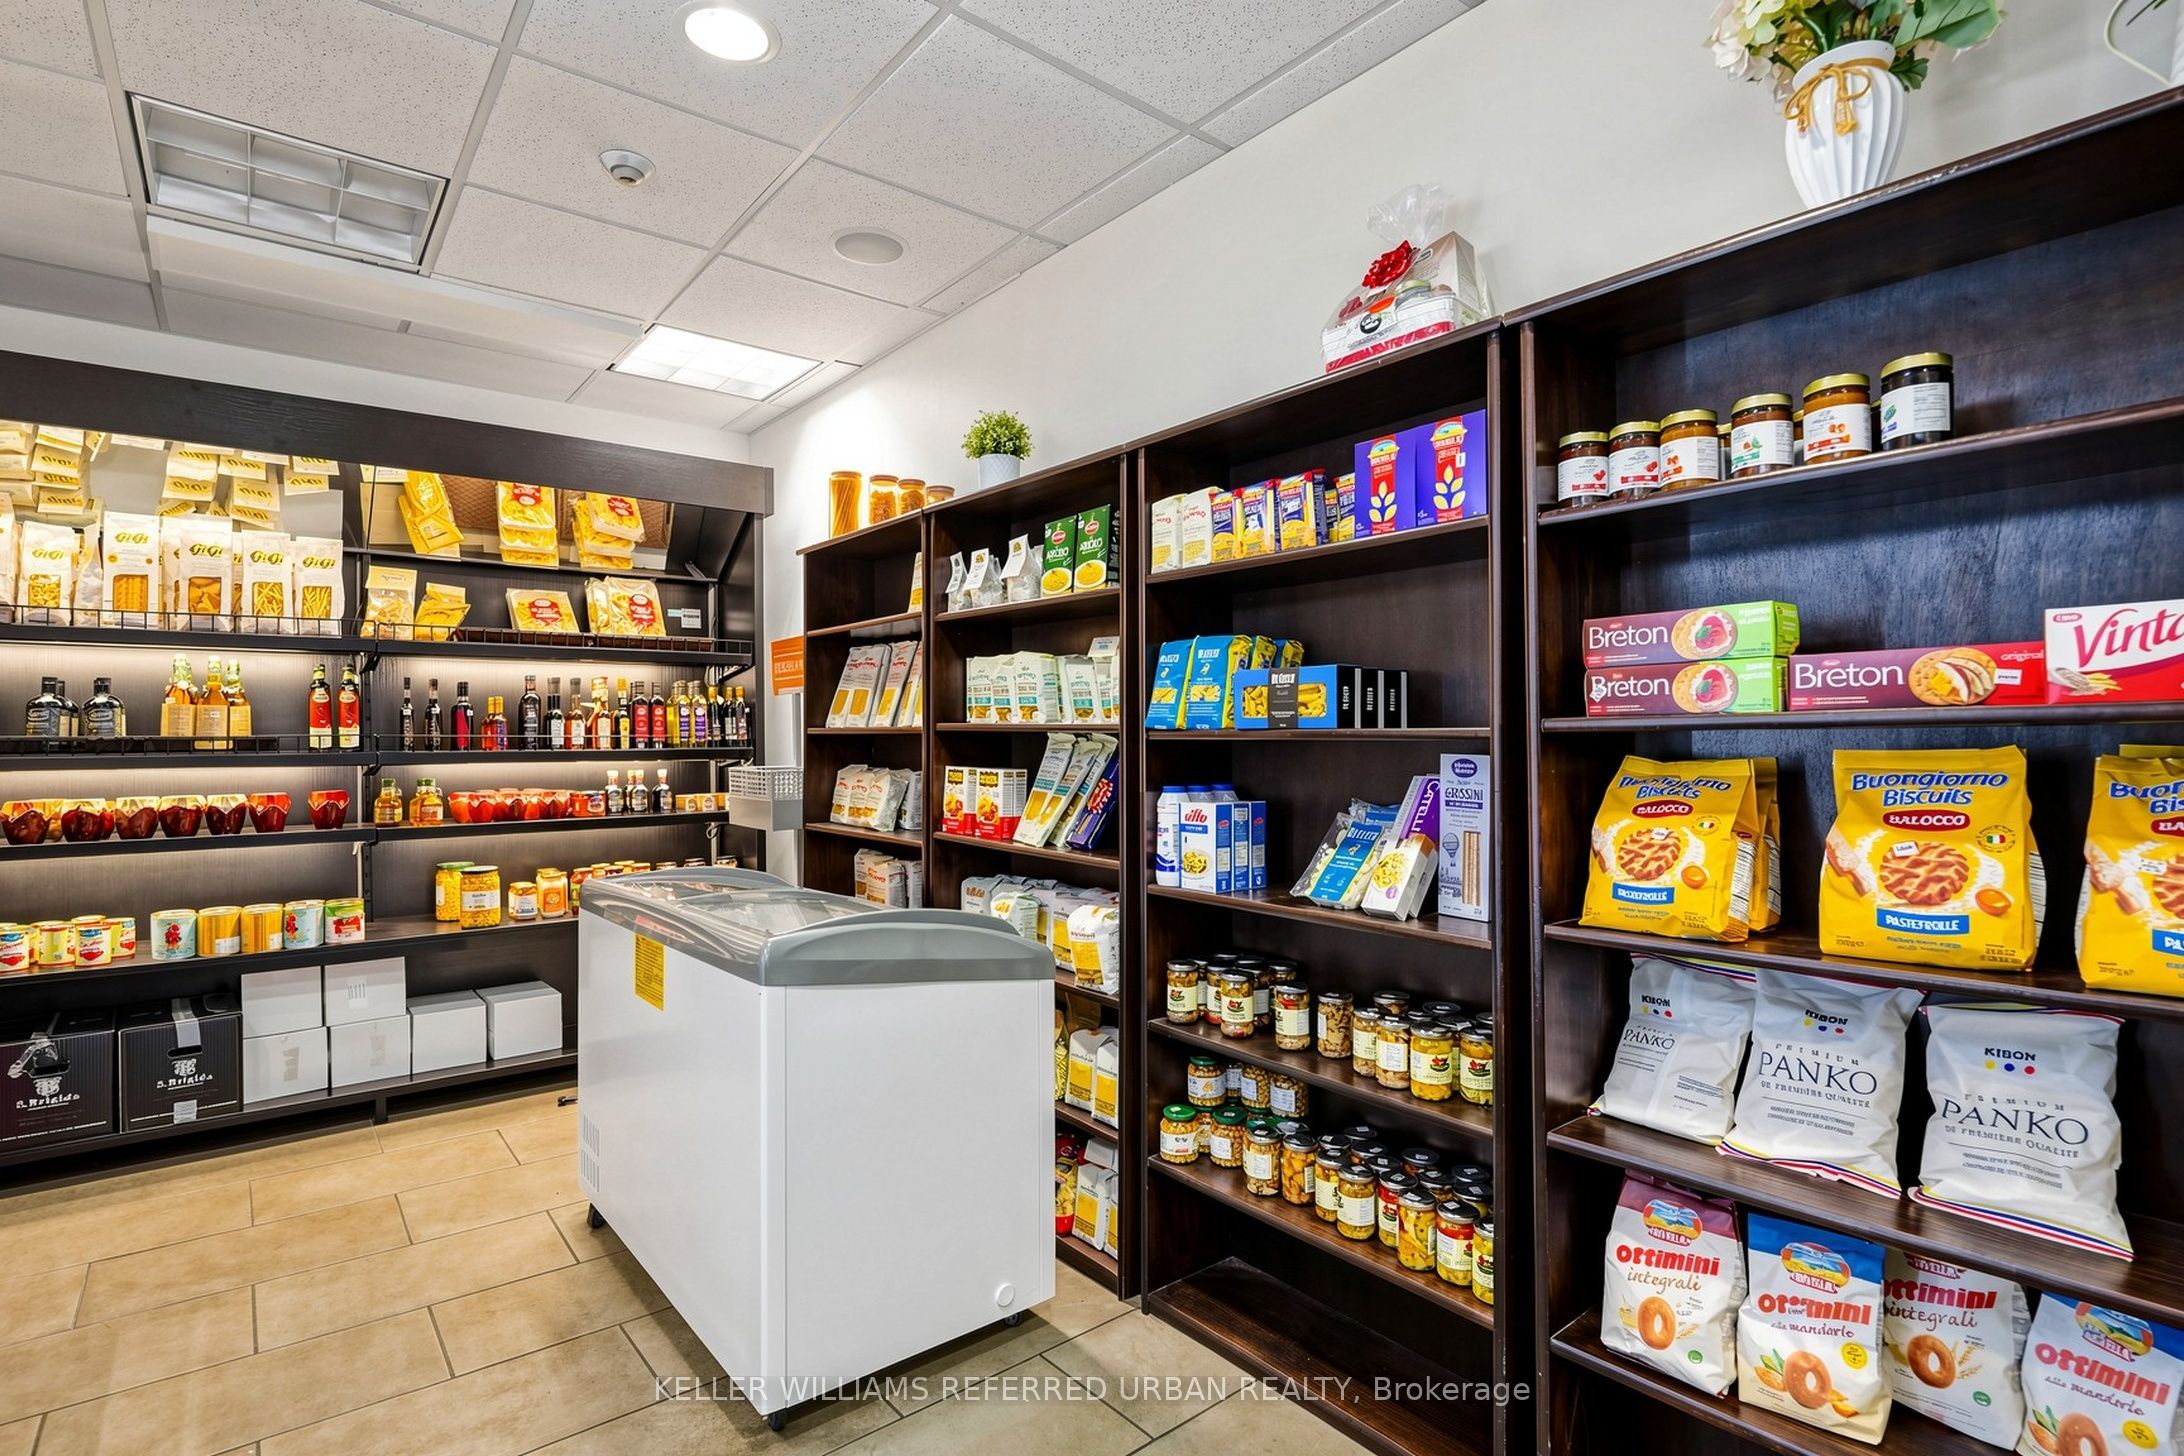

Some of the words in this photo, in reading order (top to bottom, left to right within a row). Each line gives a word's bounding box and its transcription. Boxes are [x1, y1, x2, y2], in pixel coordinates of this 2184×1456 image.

[1589, 626, 1668, 649] Breton
[1591, 676, 1670, 698] Breton
[1795, 663, 1904, 689] Breton
[1852, 770, 2010, 792] Buongiorno
[1882, 788, 1974, 806] Biscuits
[1624, 1028, 1676, 1050] PANKO
[1983, 1047, 2036, 1062] KIBON
[1758, 1051, 1878, 1096] PANKO
[1941, 1098, 2089, 1146] PANKO
[1627, 1267, 1702, 1295] integrali
[1889, 1302, 1978, 1332] integrali
